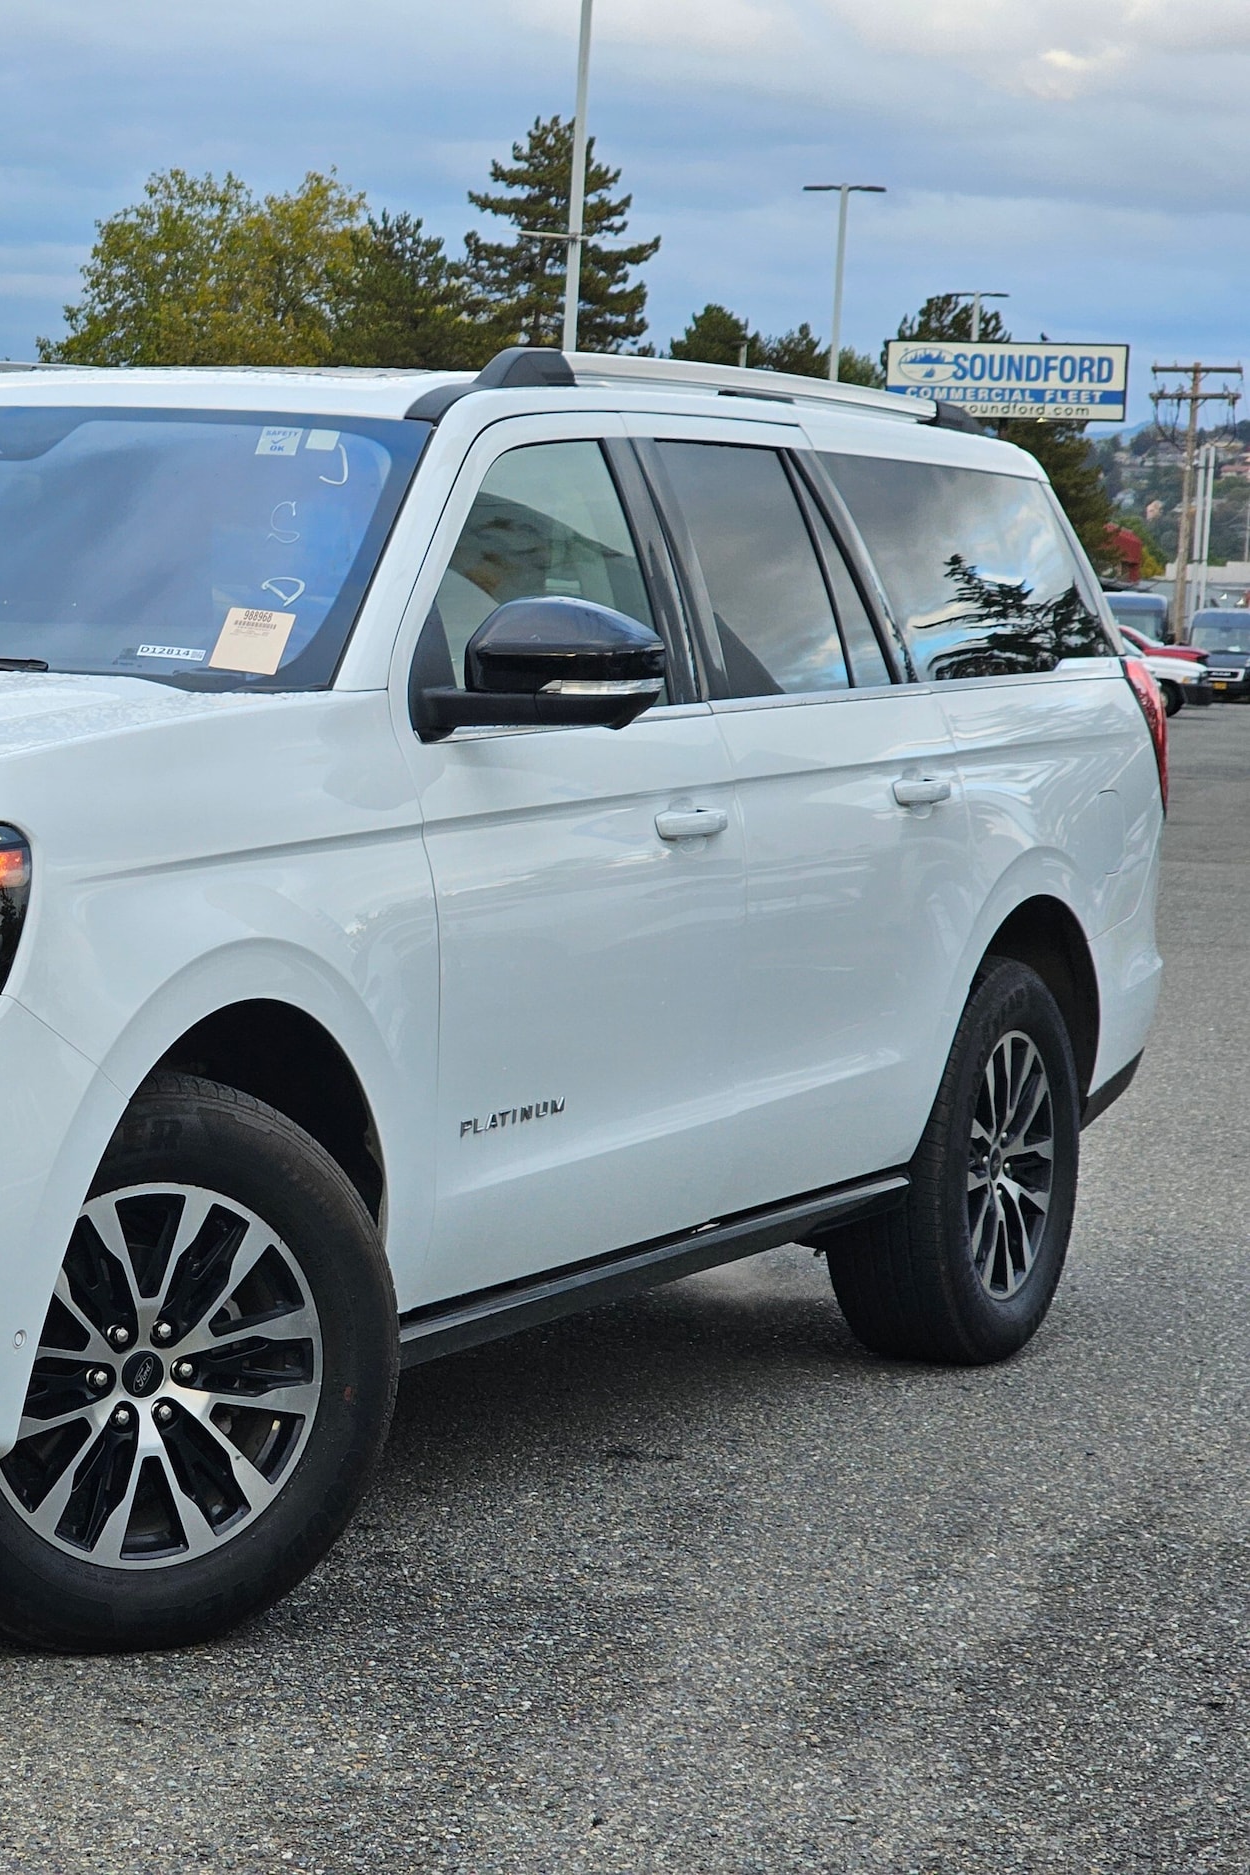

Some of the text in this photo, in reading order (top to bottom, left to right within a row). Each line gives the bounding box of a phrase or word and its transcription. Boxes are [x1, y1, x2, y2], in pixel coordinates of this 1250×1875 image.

[953, 353, 1113, 383] SOUNDFORD
[905, 386, 1102, 403] COMMERCIAL FLEET
[264, 429, 300, 437] SAFETY
[139, 645, 190, 656] D12814
[460, 1096, 565, 1138] PLATINUM
